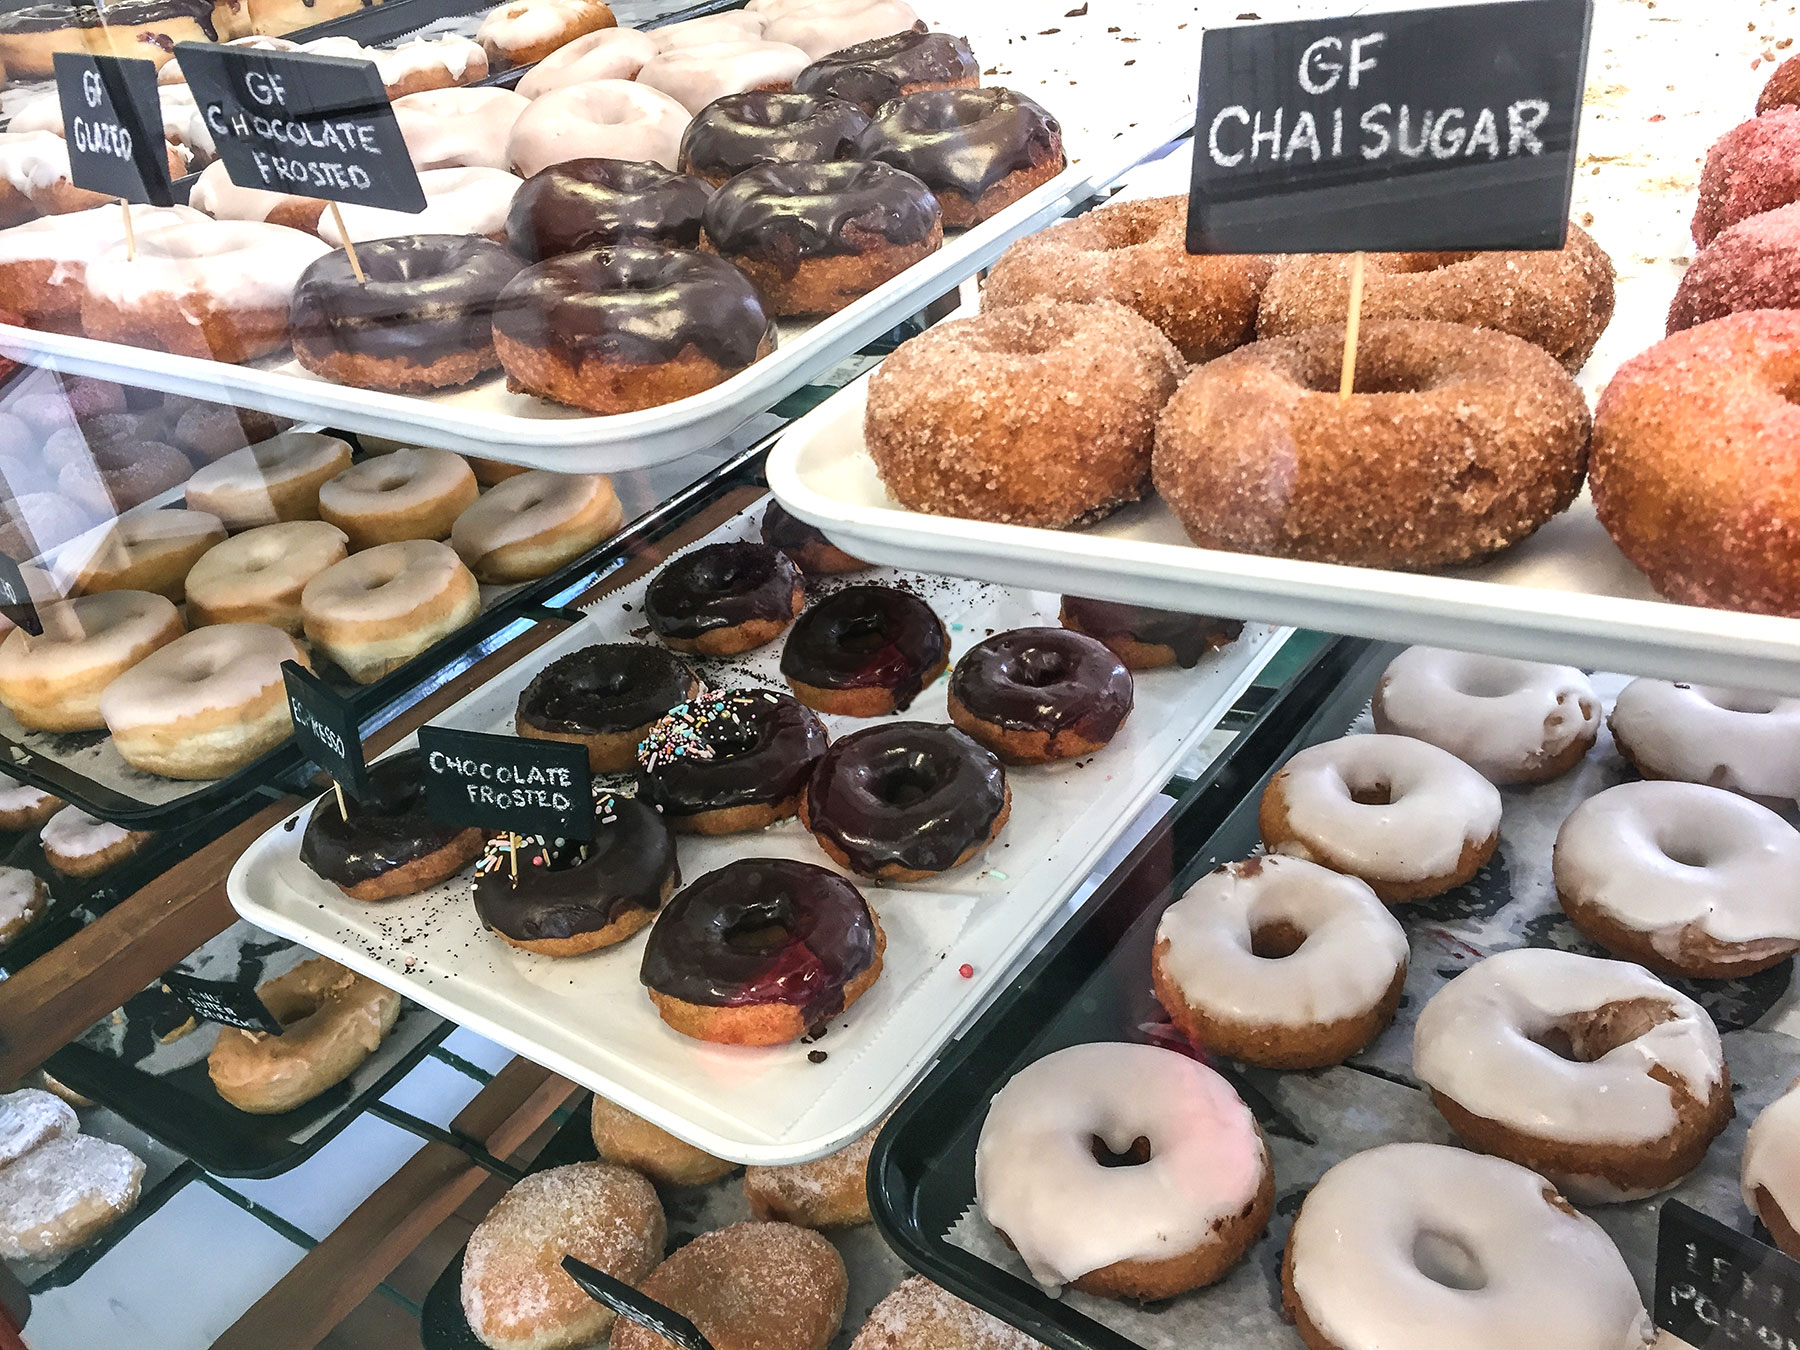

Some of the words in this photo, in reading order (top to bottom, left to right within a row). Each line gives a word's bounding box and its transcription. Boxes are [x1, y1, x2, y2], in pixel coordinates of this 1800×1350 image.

[1299, 31, 1388, 95] GF
[83, 70, 102, 107] GF
[244, 72, 288, 105] GF
[207, 104, 382, 155] CHOCOLATE
[1208, 104, 1343, 167] CHAI
[1360, 99, 1550, 161] SUGAR
[252, 151, 371, 190] FROSTED
[428, 751, 572, 787] CHOCOLATE
[467, 784, 571, 811] FROSTED
